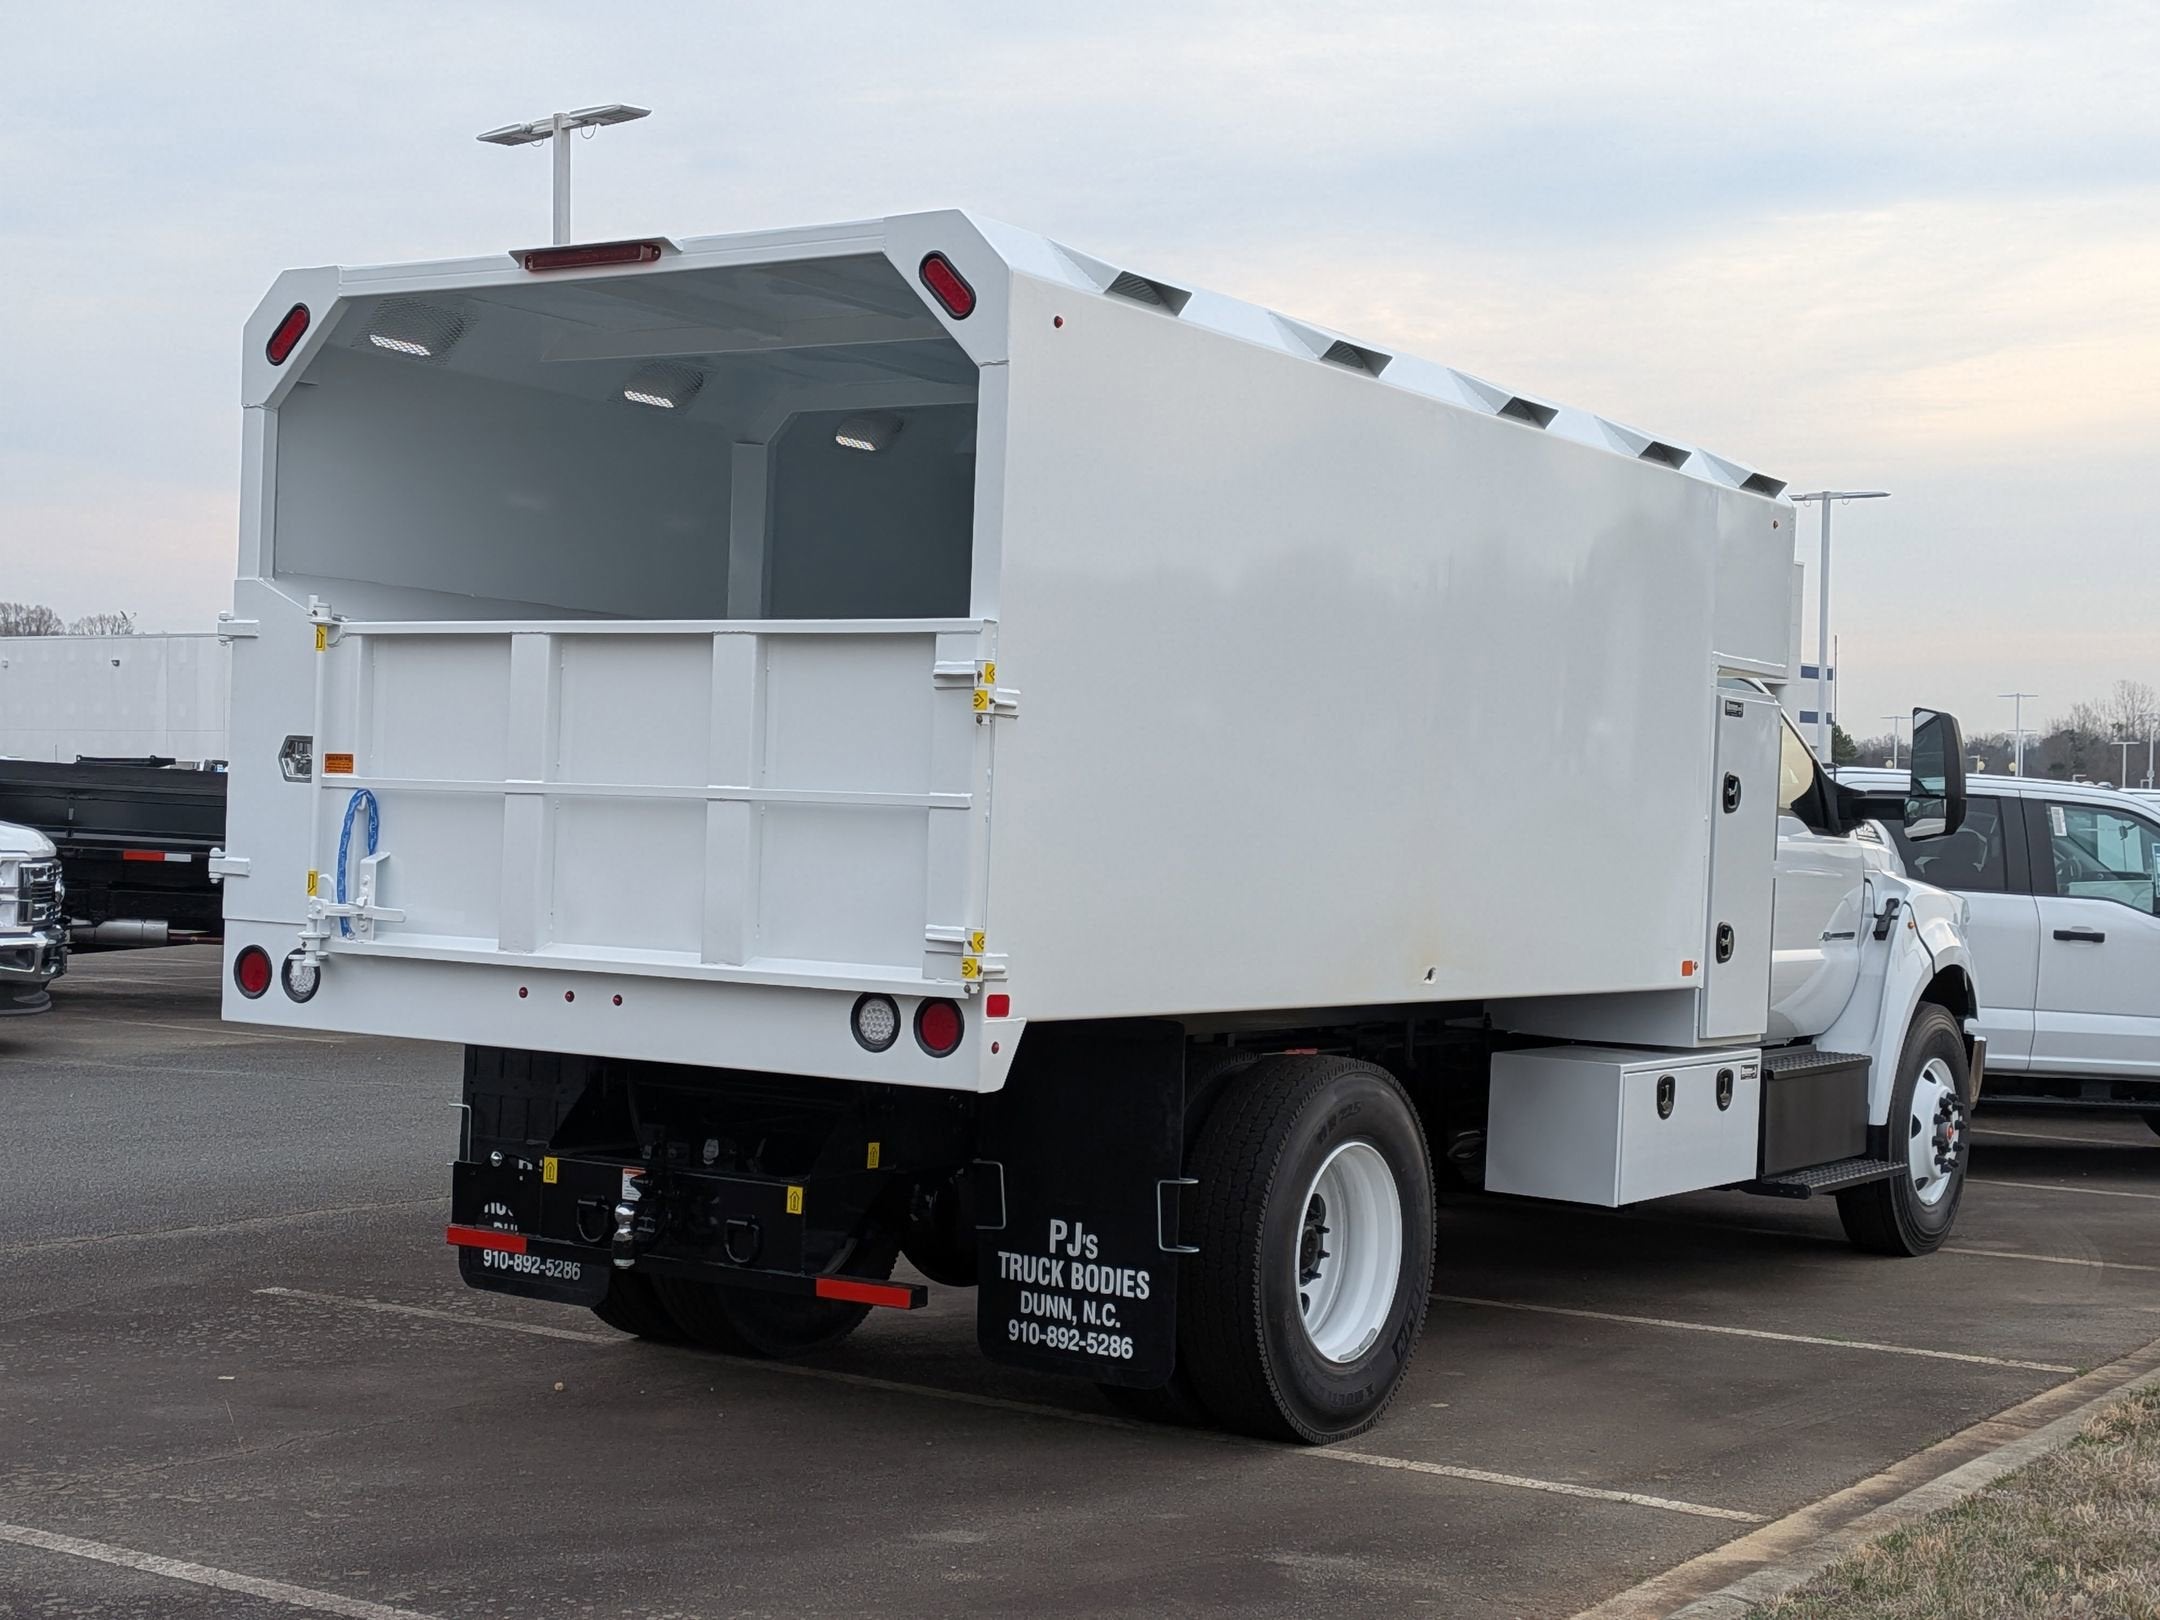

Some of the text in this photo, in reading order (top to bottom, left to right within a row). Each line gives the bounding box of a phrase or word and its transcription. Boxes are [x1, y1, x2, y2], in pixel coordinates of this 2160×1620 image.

[483, 1249, 581, 1281] 910-892-5286
[997, 1250, 1150, 1300] TRUCK BODIES
[1020, 1290, 1121, 1329] DUNN, N.C.
[1008, 1319, 1134, 1360] 910-892-5286
